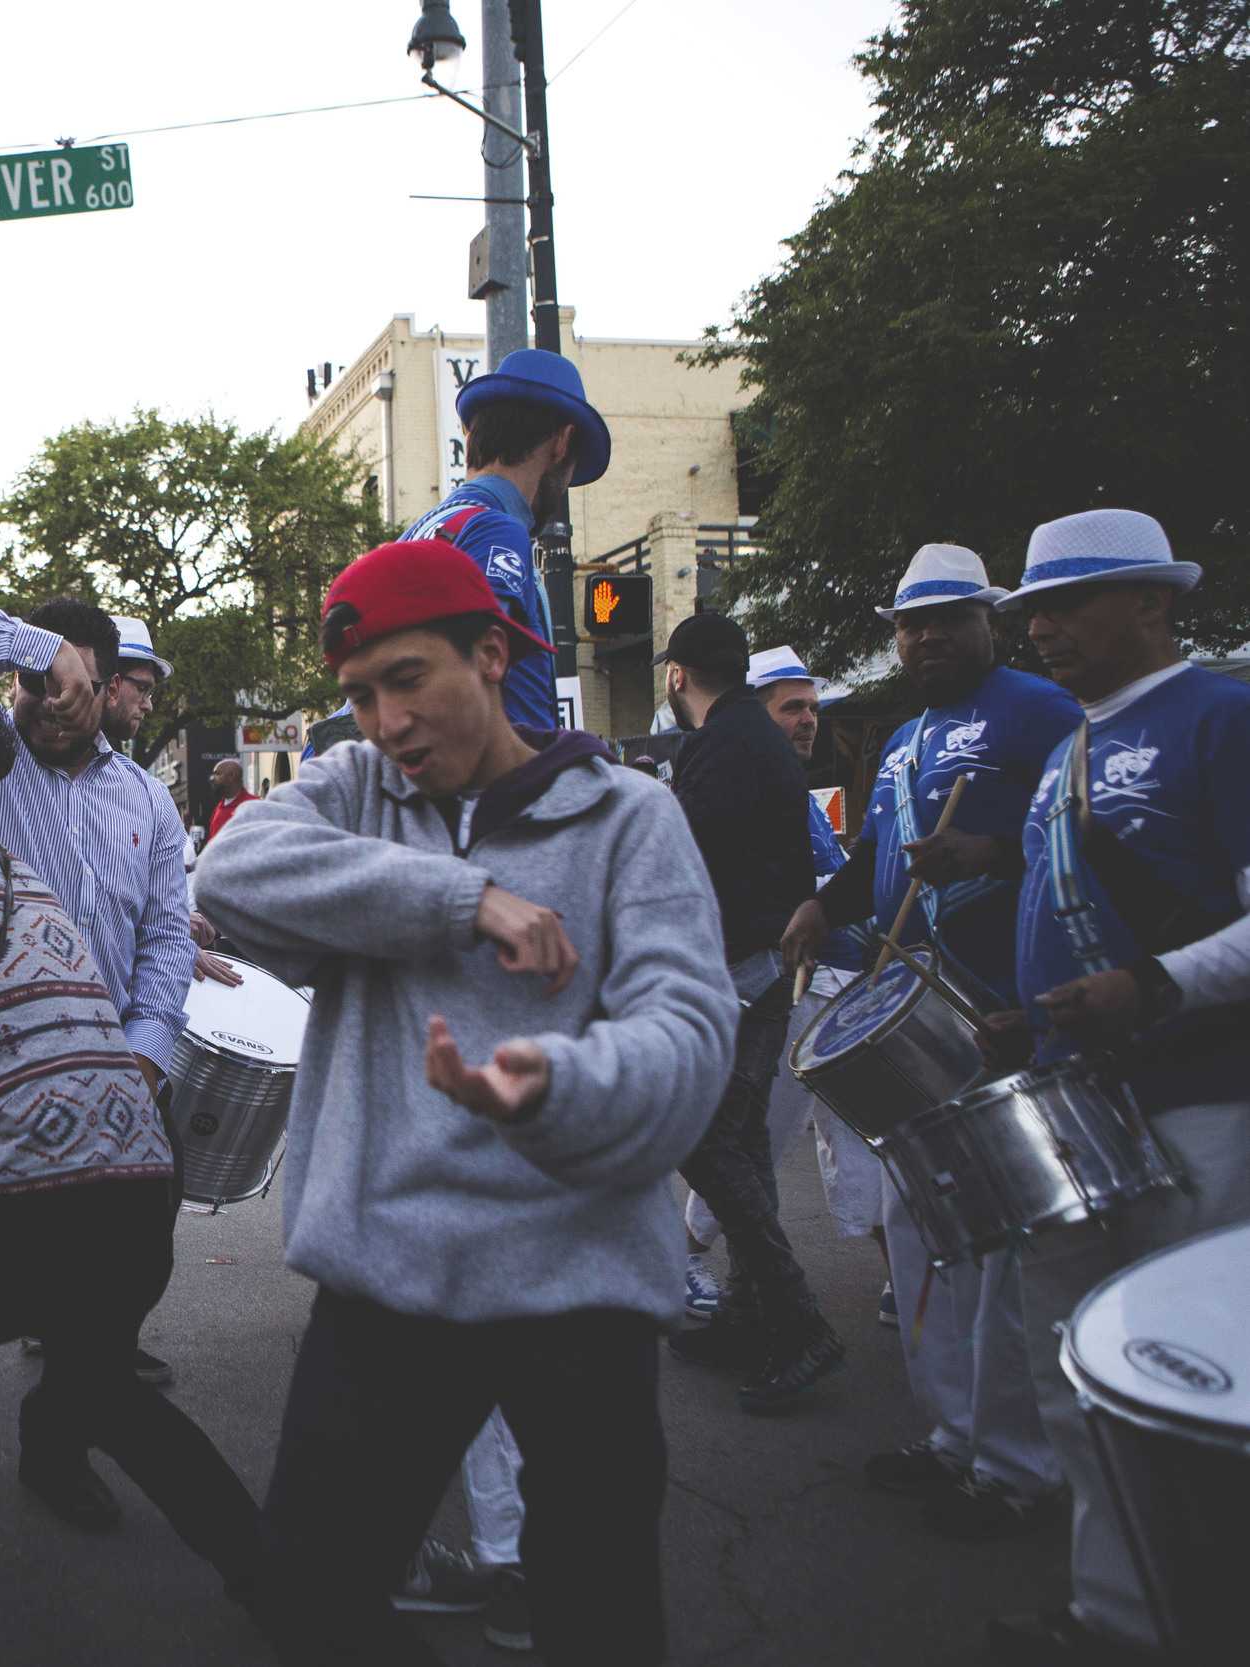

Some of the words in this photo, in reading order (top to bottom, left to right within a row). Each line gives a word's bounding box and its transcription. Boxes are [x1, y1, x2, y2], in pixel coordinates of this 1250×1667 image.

[100, 145, 129, 171] ST
[85, 180, 132, 209] 600
[217, 1031, 267, 1053] EVANS
